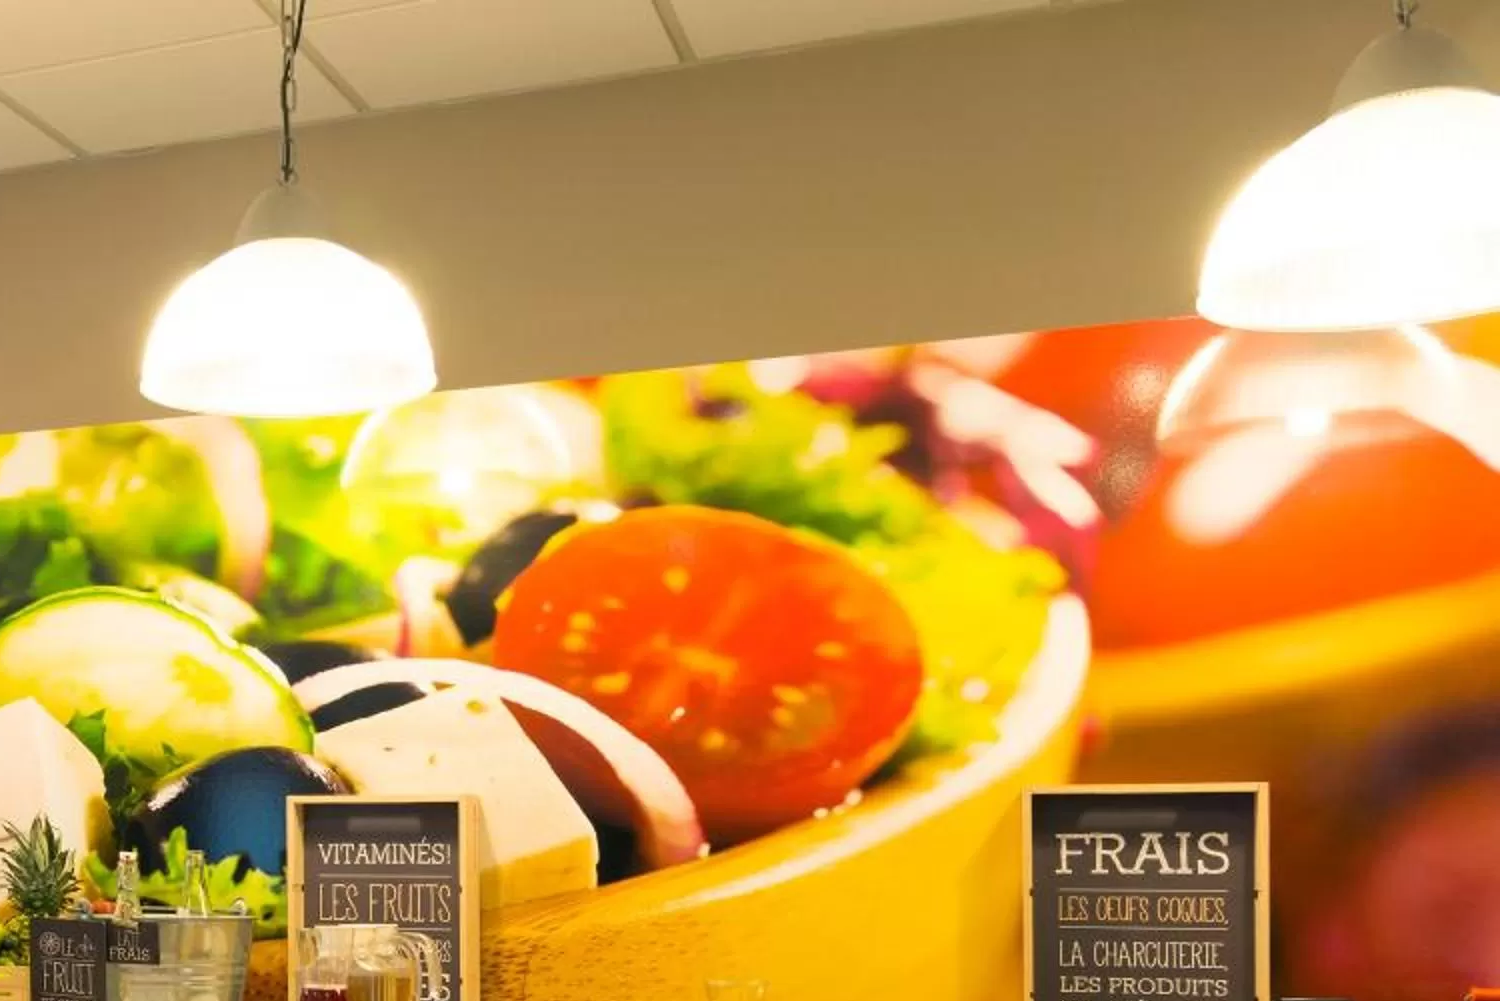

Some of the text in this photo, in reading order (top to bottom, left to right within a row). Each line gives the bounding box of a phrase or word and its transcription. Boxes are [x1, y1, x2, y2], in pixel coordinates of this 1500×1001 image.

[318, 836, 452, 866] VITAMINÉS!
[1054, 831, 1231, 877] FRAIS
[318, 882, 452, 923] LES FRUITS
[1058, 895, 1089, 921] LES
[109, 947, 151, 961] FRAIS
[1058, 939, 1085, 967] LA
[43, 959, 96, 995] FRUIT
[1060, 975, 1229, 997] LES PRODUITS
